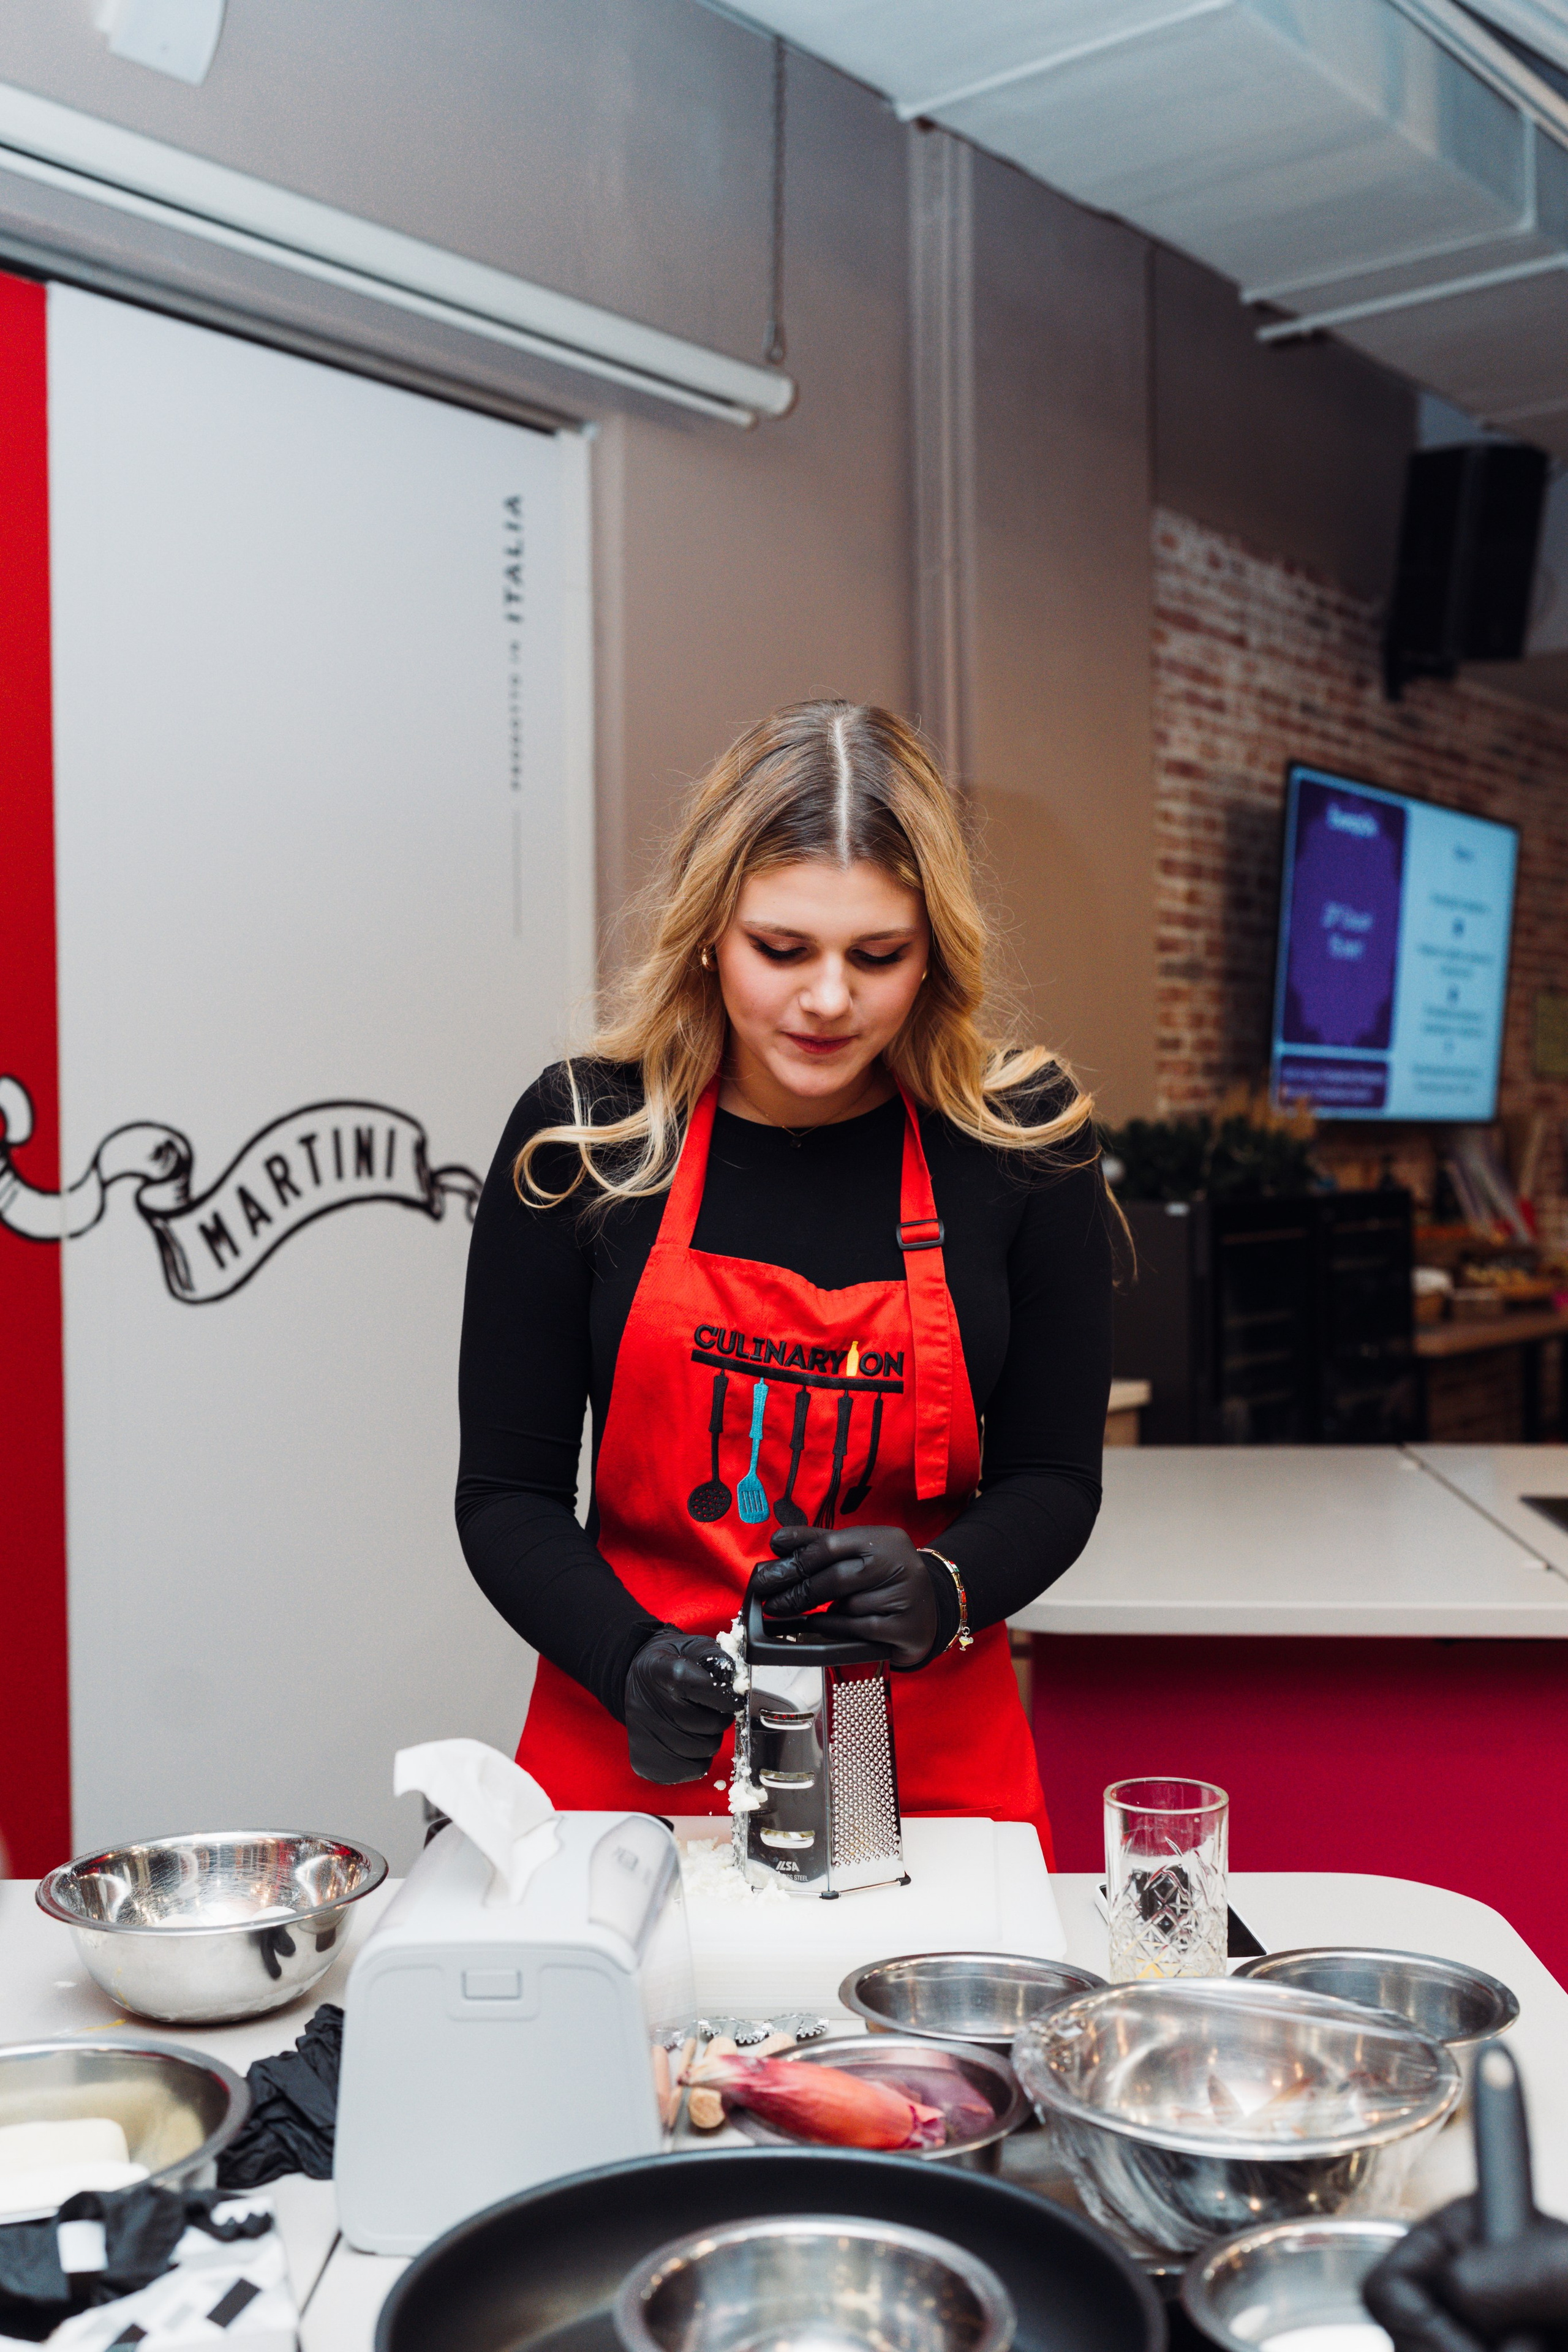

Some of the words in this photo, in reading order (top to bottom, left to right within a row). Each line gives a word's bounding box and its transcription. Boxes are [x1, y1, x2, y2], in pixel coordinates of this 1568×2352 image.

[503, 494, 524, 624] ITALIA
[197, 1125, 396, 1270] MARTINI
[775, 1861, 800, 1871] ILSA
